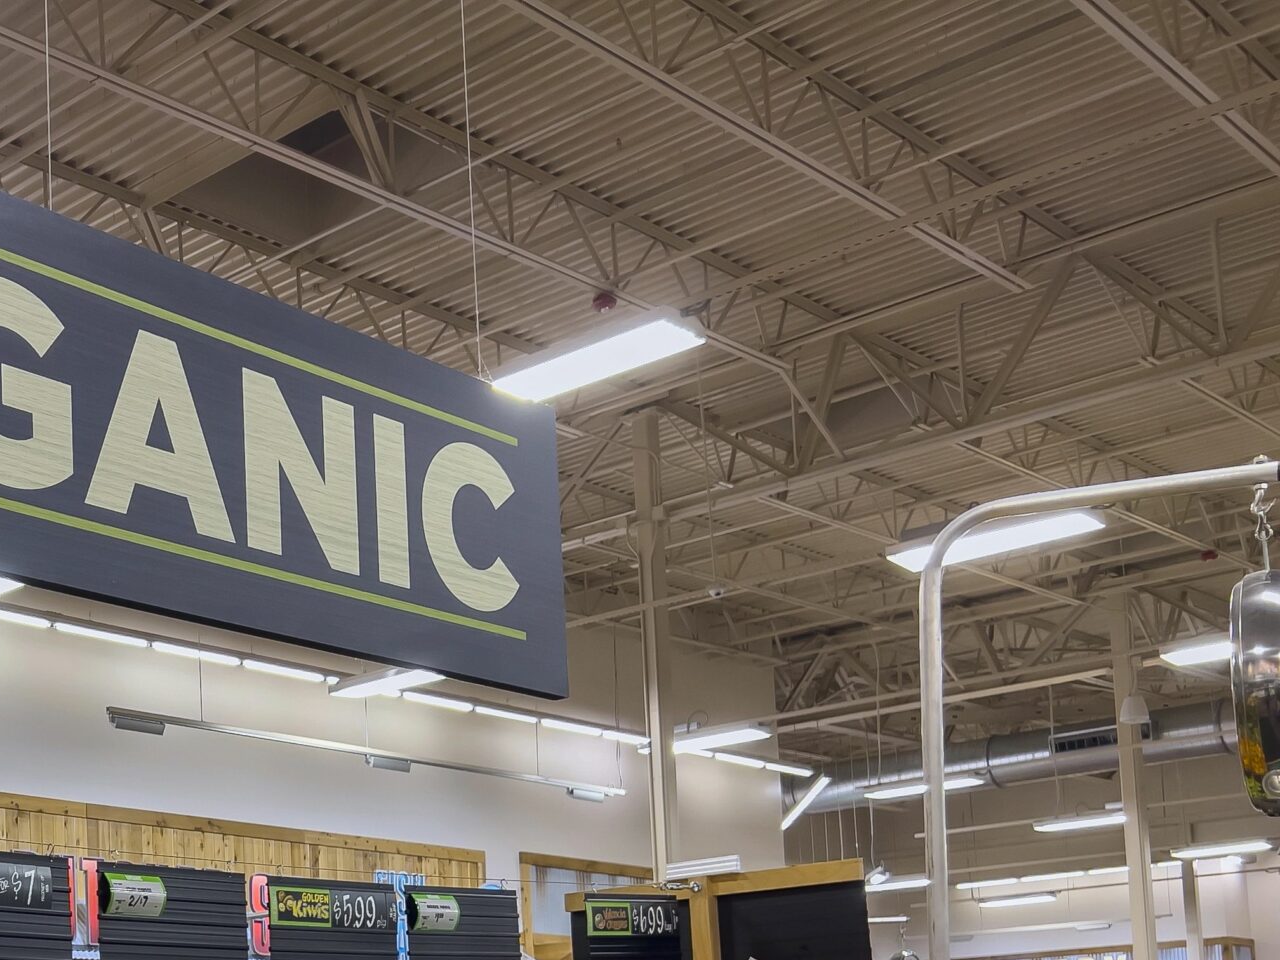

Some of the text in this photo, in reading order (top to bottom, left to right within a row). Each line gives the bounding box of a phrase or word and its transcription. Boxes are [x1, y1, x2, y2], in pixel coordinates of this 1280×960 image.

[301, 893, 329, 904] GOLDEN
[333, 894, 376, 928] $5.99
[632, 904, 664, 935] $6.99
